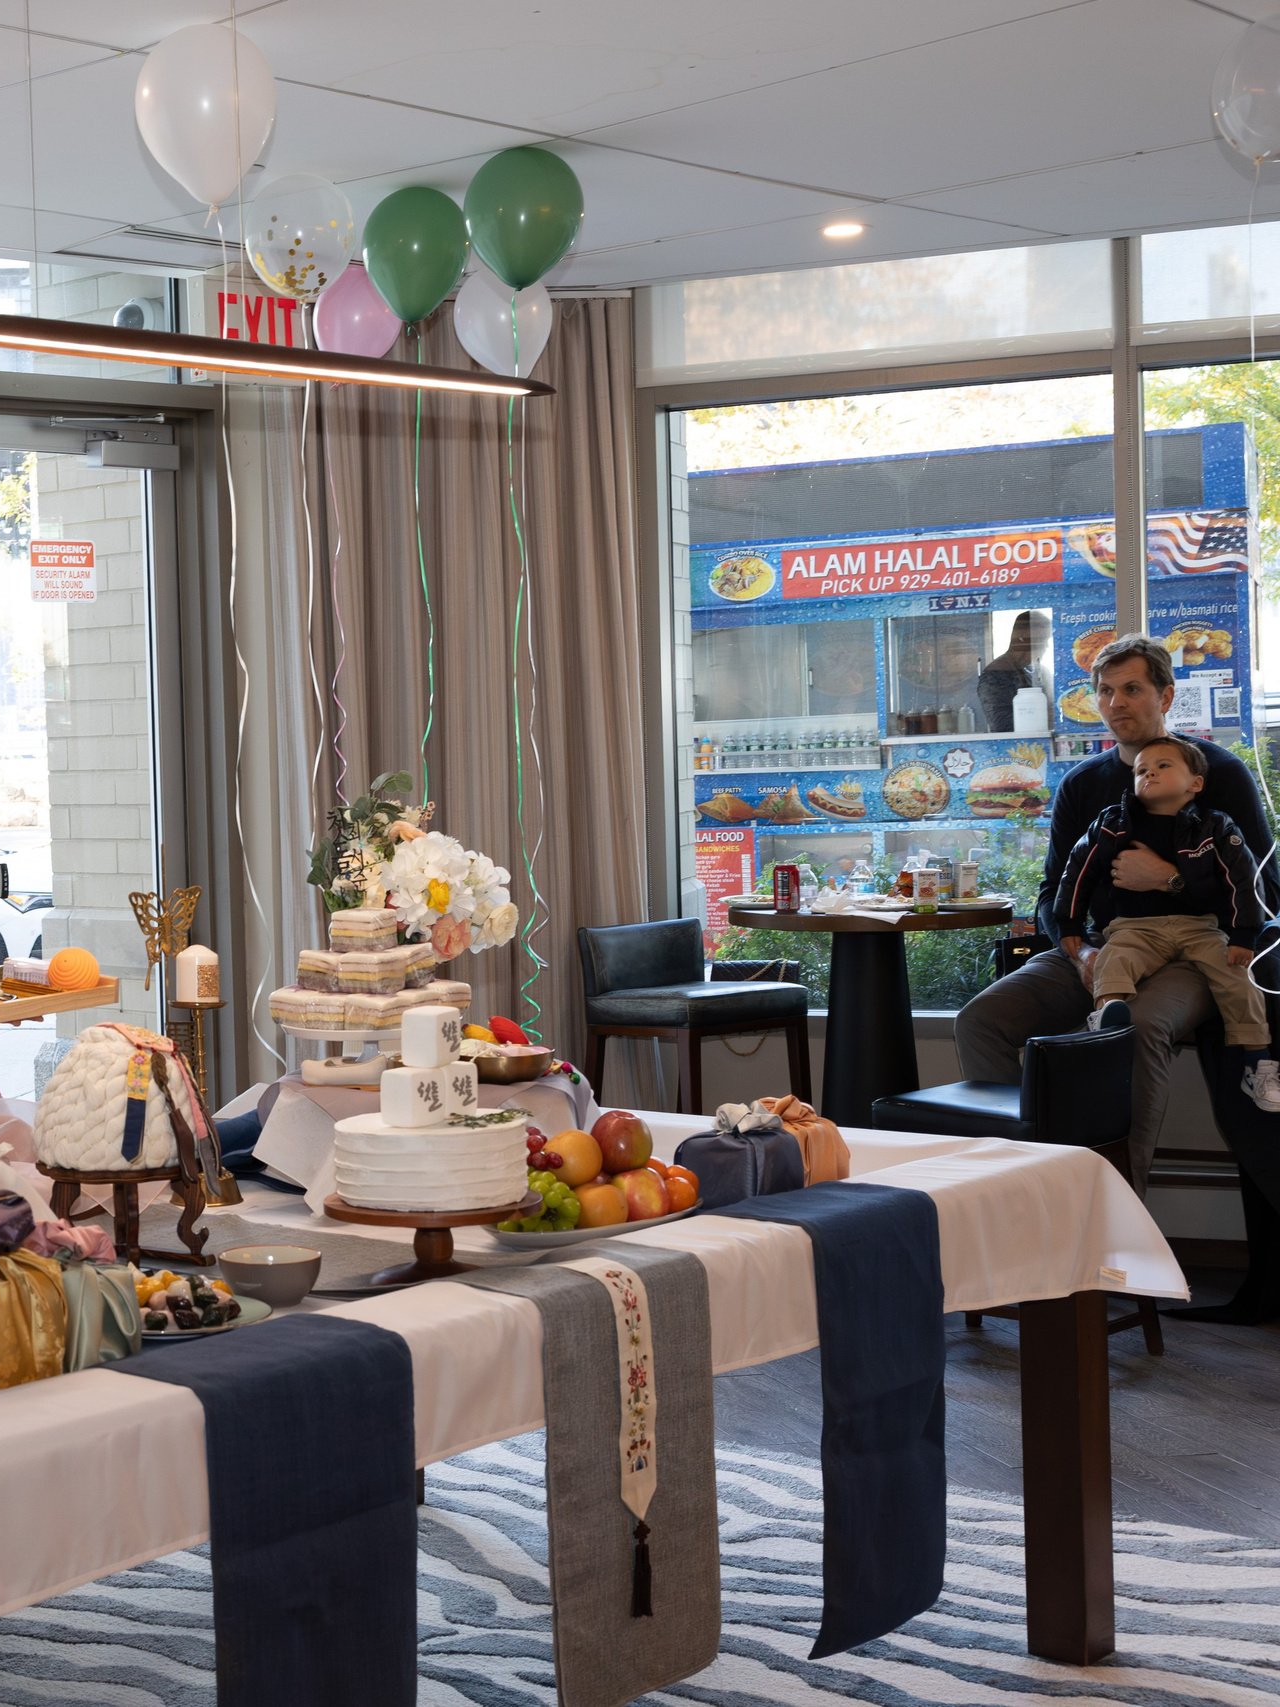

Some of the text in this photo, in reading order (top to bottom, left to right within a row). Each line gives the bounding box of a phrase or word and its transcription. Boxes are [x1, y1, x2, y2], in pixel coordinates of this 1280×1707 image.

[218, 292, 297, 347] EXIT
[32, 544, 92, 554] EMERGENCY
[38, 555, 87, 564] EXIT ONLY
[787, 538, 1058, 579] ALAM HALAL FOOD
[35, 570, 91, 579] SECURITY ALARM
[44, 580, 83, 589] WILL SOUND
[820, 567, 1021, 595] PICK UP 929-401-6189
[33, 590, 94, 599] IF DOOR IS OPENED
[1169, 602, 1218, 619] w/basmati
[1219, 602, 1238, 614] rice
[1060, 612, 1087, 624] Fresh
[980, 757, 1034, 767] CHEESEBURGER
[758, 786, 788, 794] SAMOSA
[695, 831, 745, 843] LAL FOOD
